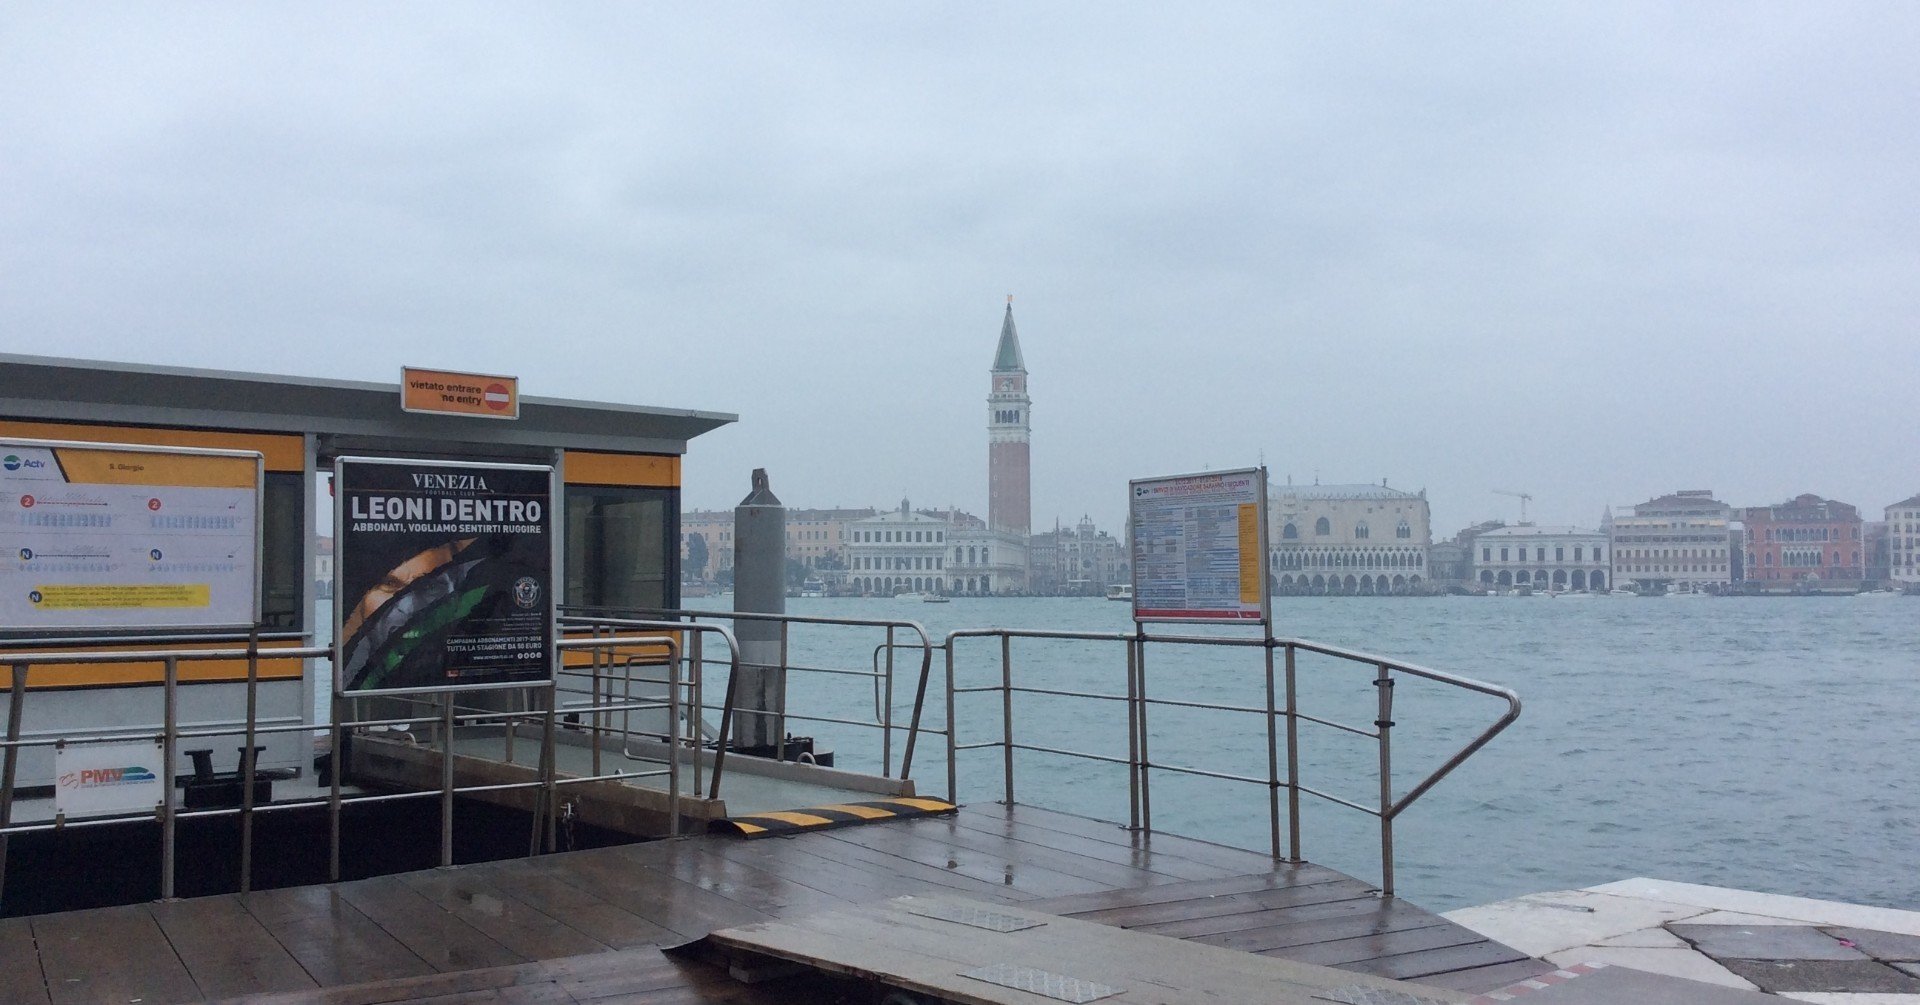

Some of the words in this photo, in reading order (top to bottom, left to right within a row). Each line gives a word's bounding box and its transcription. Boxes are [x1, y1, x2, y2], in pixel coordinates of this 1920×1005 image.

[410, 381, 444, 391] vietato
[446, 384, 482, 394] entrare
[442, 394, 454, 402] no
[456, 395, 482, 406] entry
[23, 458, 45, 468] Actv
[118, 463, 144, 472] Giorgio
[412, 473, 488, 490] VENEZIA
[351, 496, 433, 520] LEONI
[440, 499, 541, 523] DENTRO
[352, 522, 407, 533] ABBONATI,
[408, 523, 457, 533] VOGLIAMO
[459, 524, 501, 533] SENTIRTI
[502, 525, 541, 534] RUGGIRE
[477, 643, 507, 651] STAGIONE
[80, 768, 124, 783] PMV
